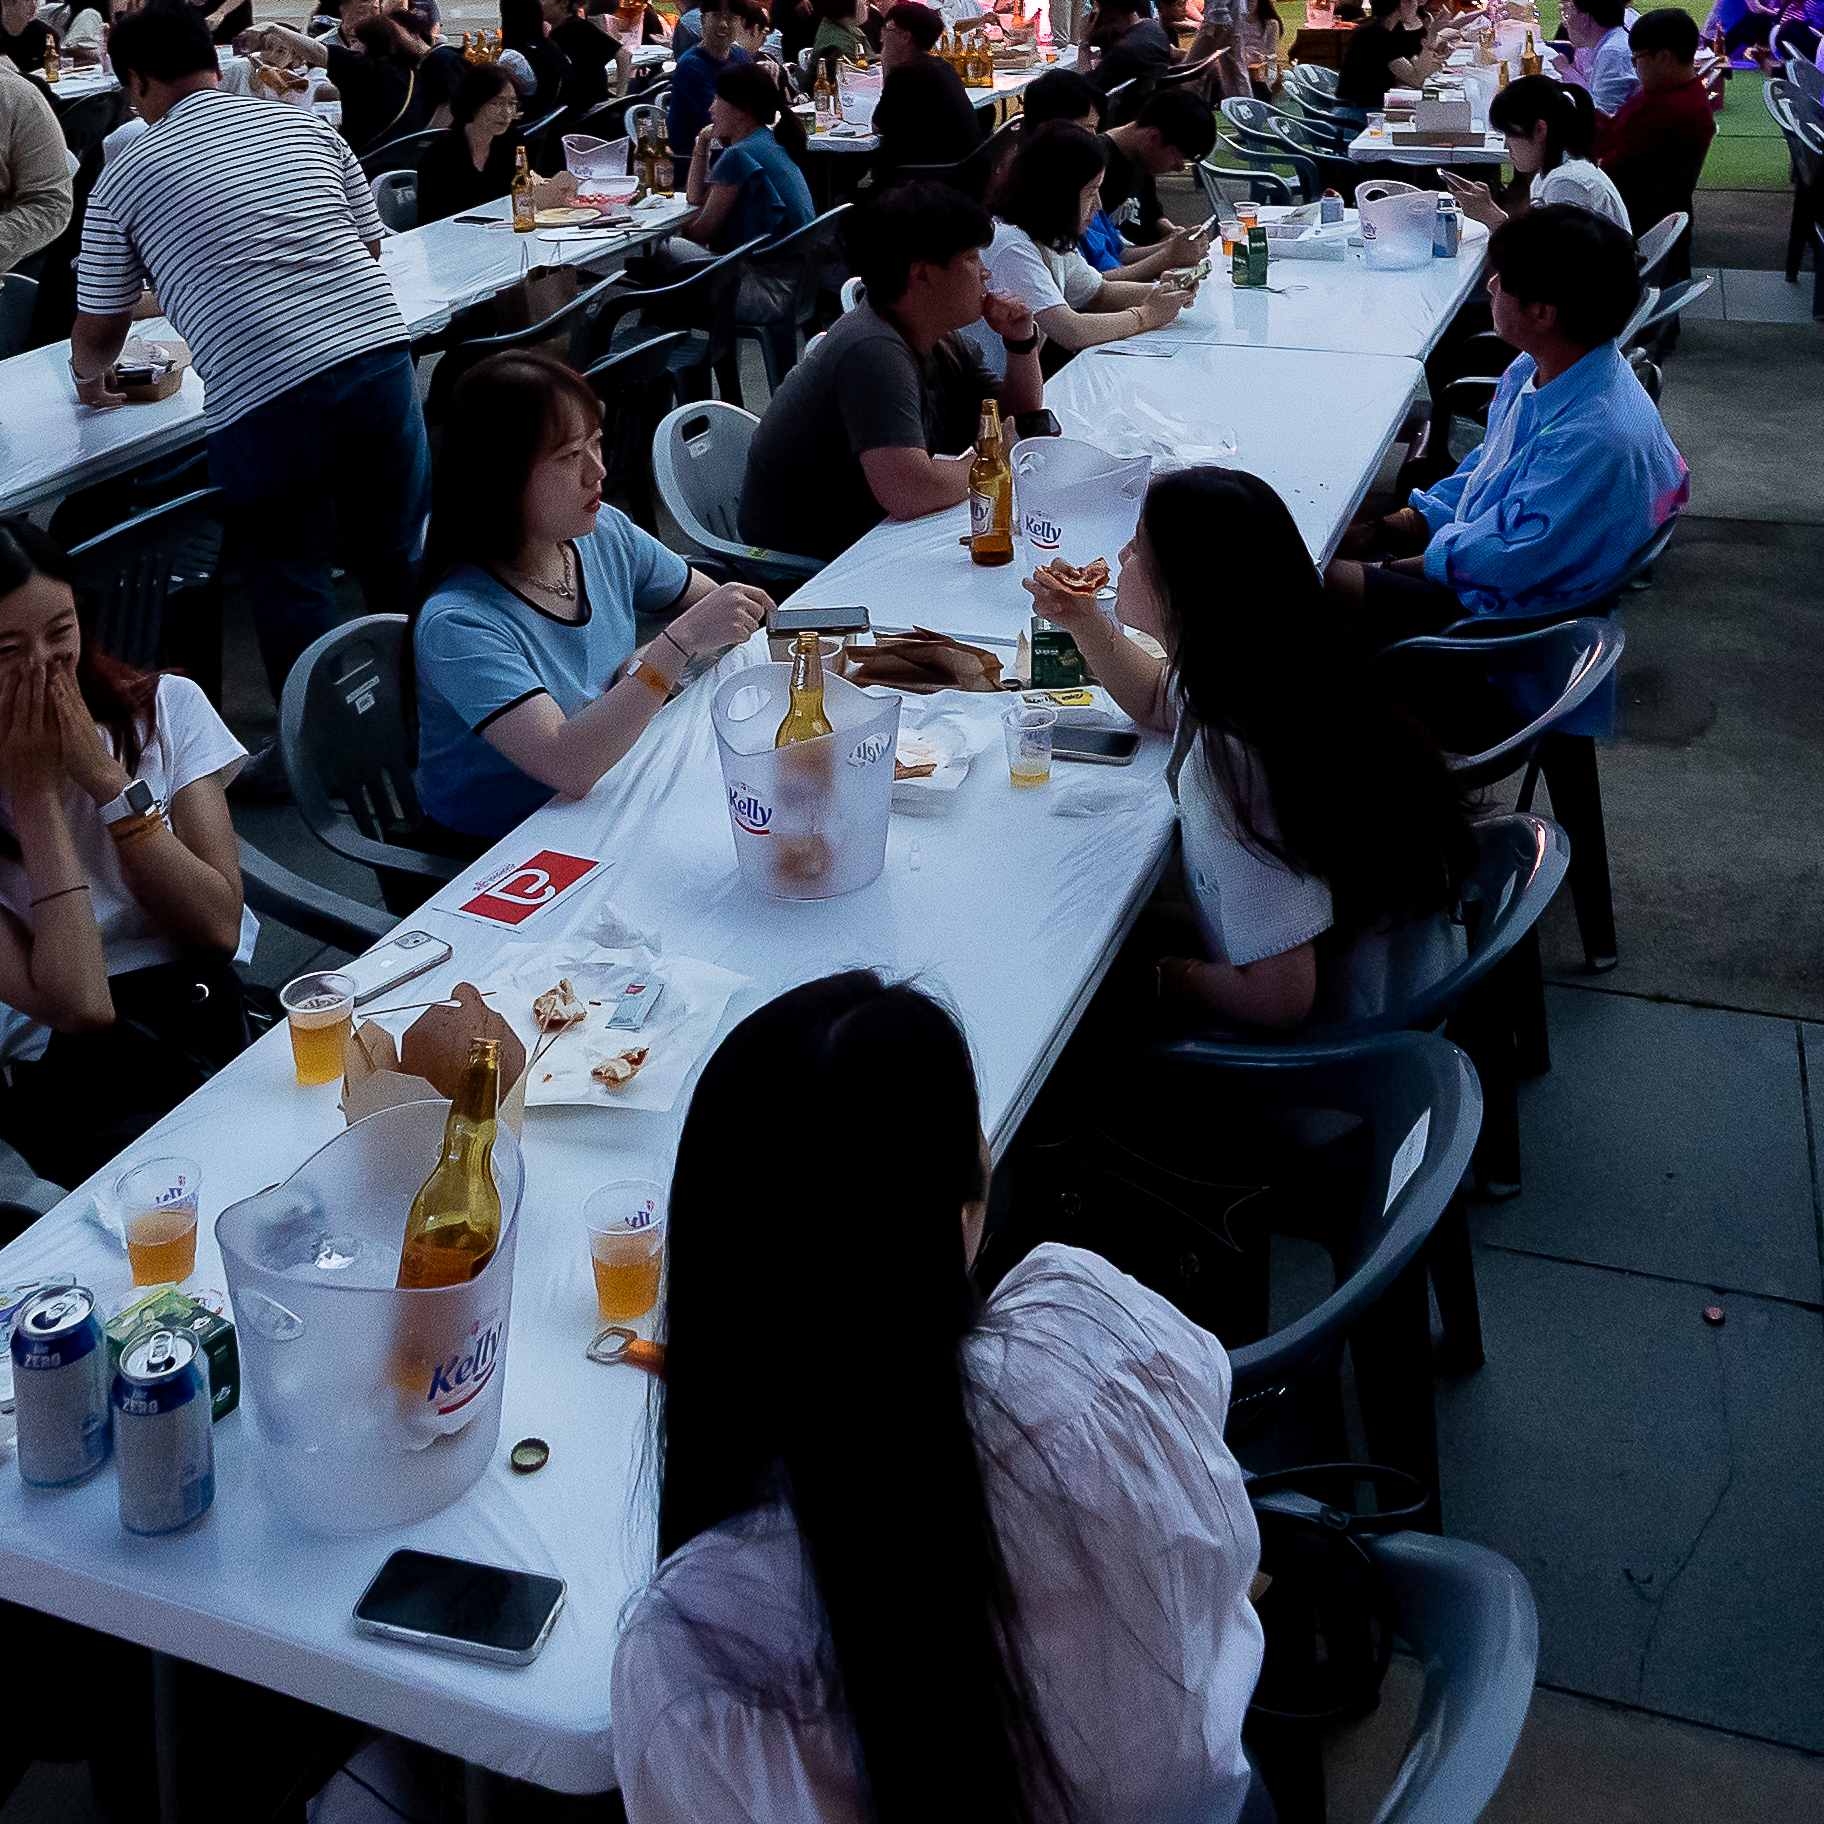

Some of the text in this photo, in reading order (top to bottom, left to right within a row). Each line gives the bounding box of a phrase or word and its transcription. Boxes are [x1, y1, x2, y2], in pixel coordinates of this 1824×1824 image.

[971, 502, 989, 522] lly
[1025, 514, 1062, 543] Kelly
[727, 784, 773, 829] Kelly
[24, 1352, 62, 1368] ZERO
[428, 1321, 505, 1402] Kelly
[122, 1397, 159, 1413] ZERO
